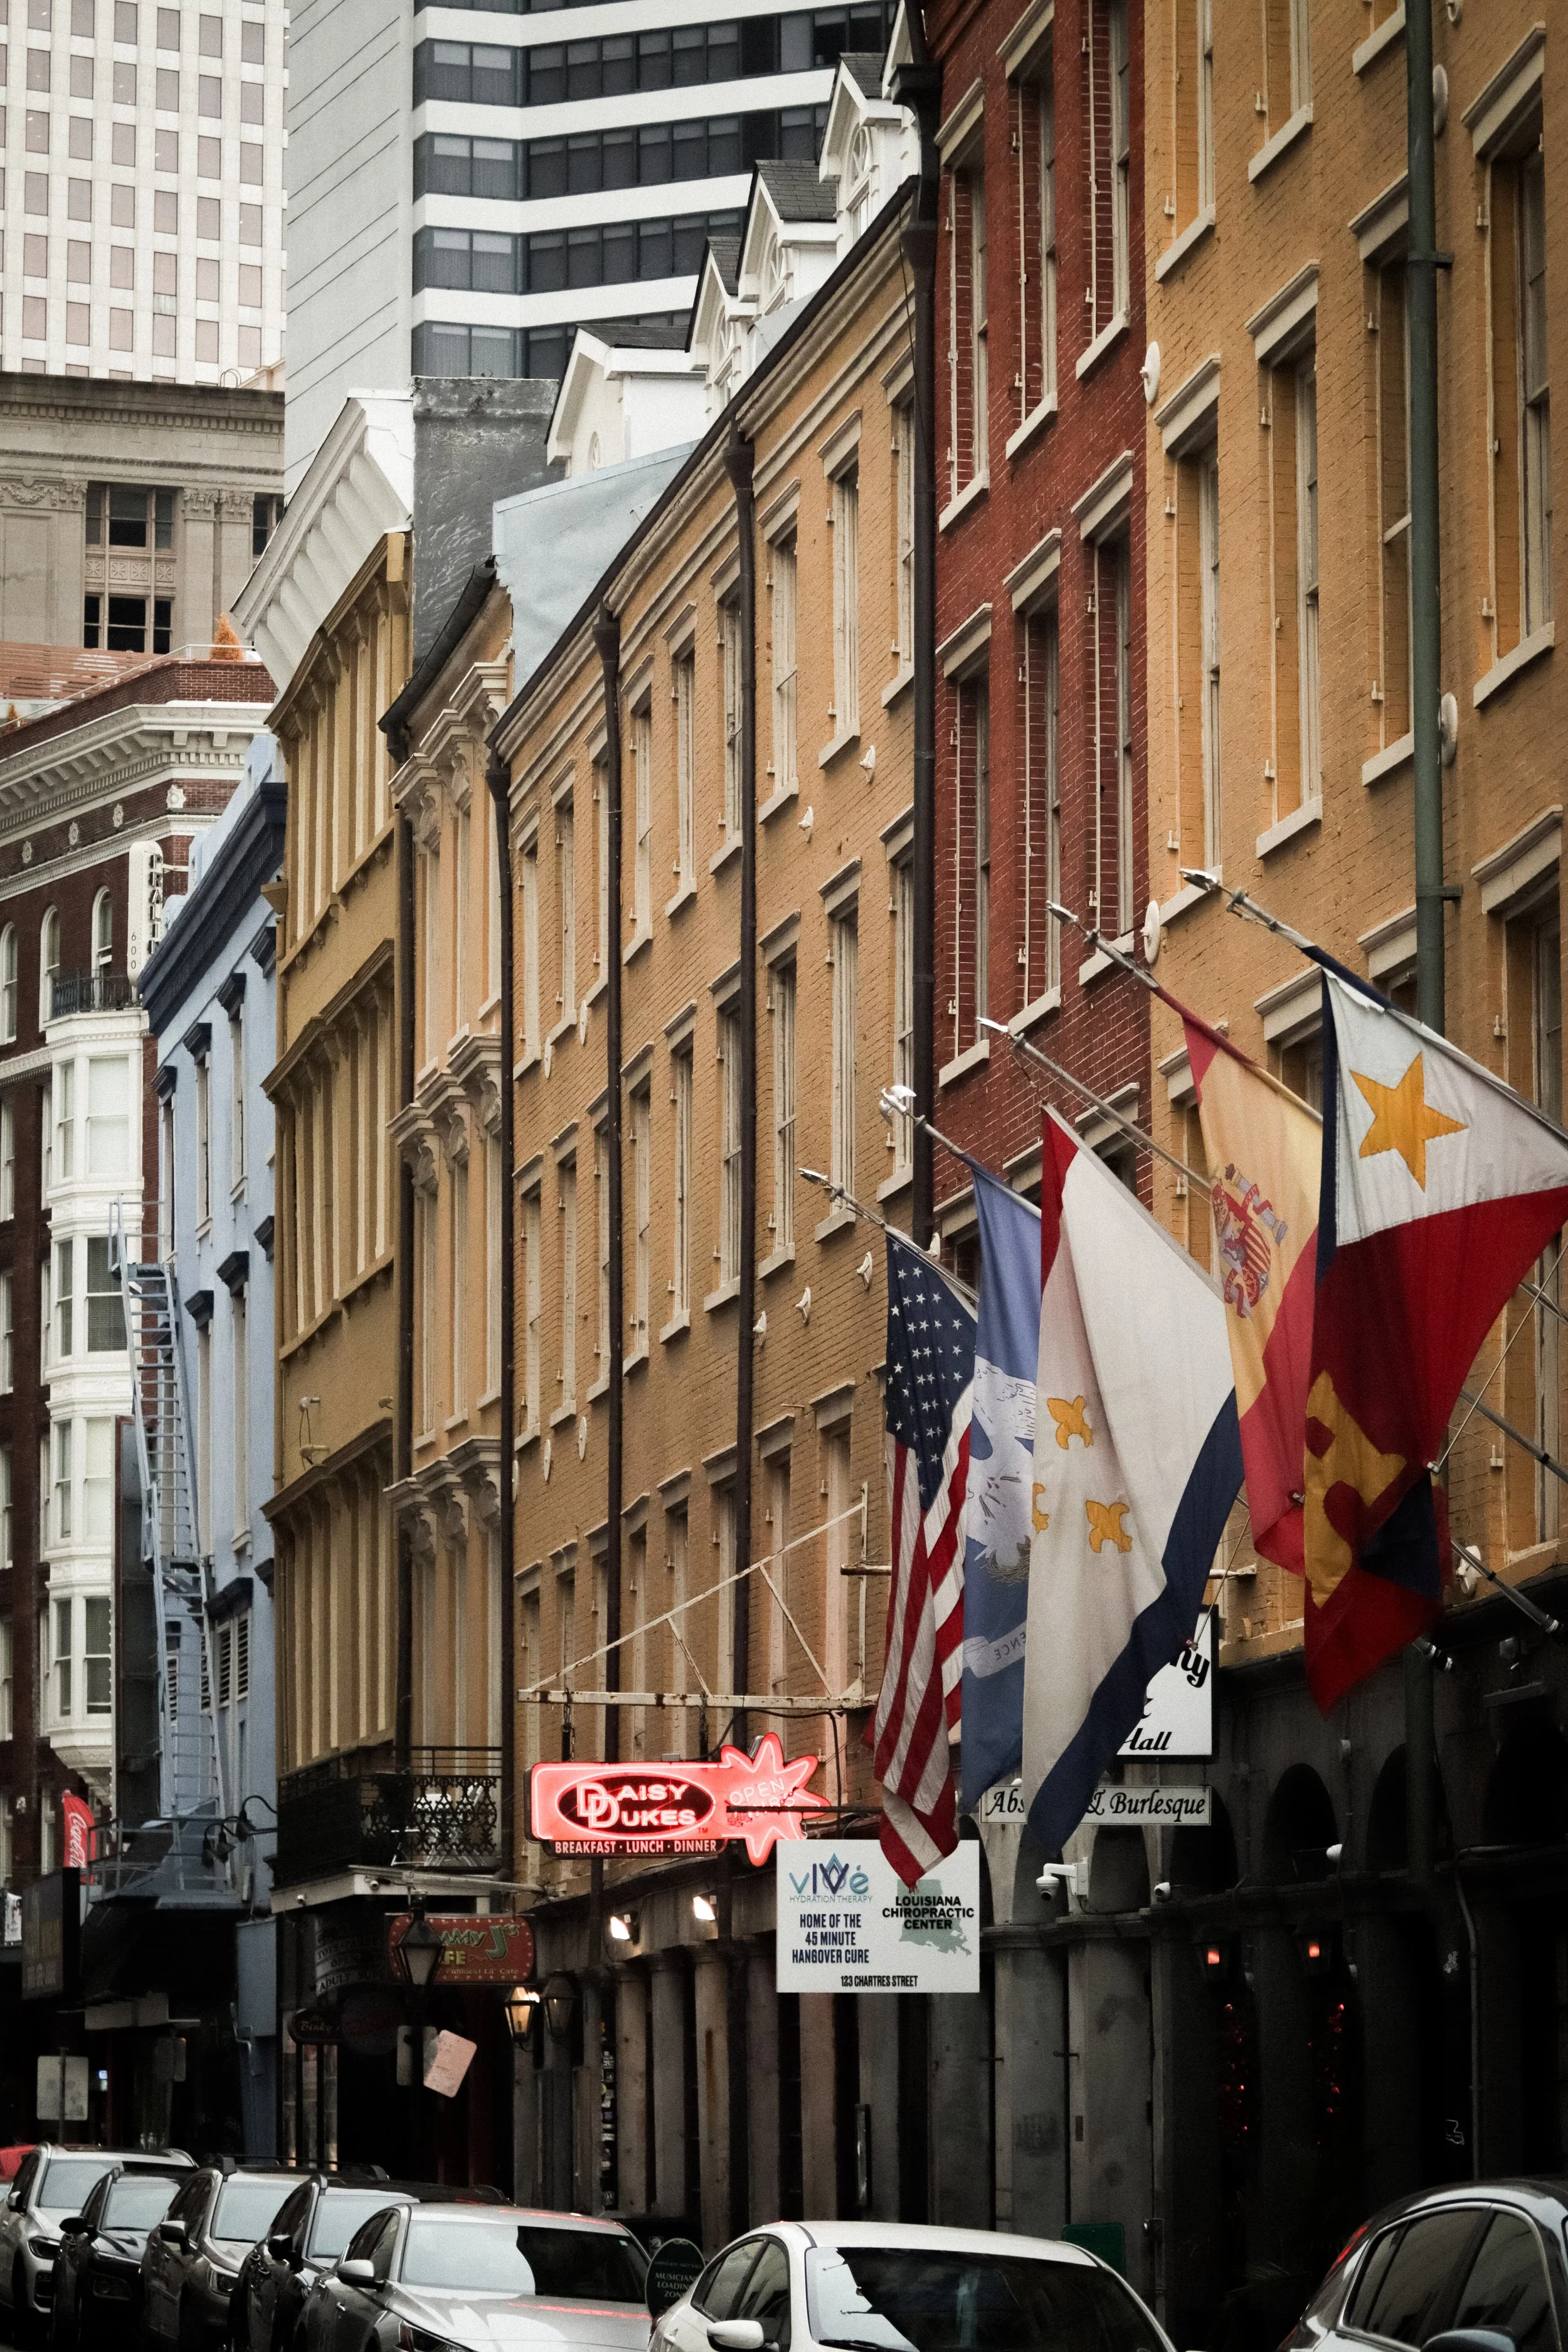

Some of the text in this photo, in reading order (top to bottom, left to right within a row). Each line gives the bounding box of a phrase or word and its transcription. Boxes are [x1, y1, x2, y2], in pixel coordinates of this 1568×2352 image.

[729, 1777, 785, 1806] OPEN
[576, 1782, 689, 1818] DAISY
[1110, 1789, 1206, 1823] Burlesque
[588, 1794, 697, 1829] DUKES
[554, 1840, 717, 1854] BREAKFAST LUNCH DINNER
[790, 1895, 872, 1903] HYDRATION THERAPY
[895, 1895, 961, 1907] LOUISIANA
[882, 1907, 975, 1918] CHIROPRACTIC
[800, 1914, 861, 1929] HOME OF THE
[904, 1919, 953, 1930] CENTER
[805, 1931, 856, 1946] 45 MINUTE
[792, 1949, 869, 1964] HANGOVER CURE
[840, 1975, 918, 1987] 123 CHARTRES STREET
[657, 2281, 690, 2291] LOADIN
[664, 2290, 684, 2299] ZON
